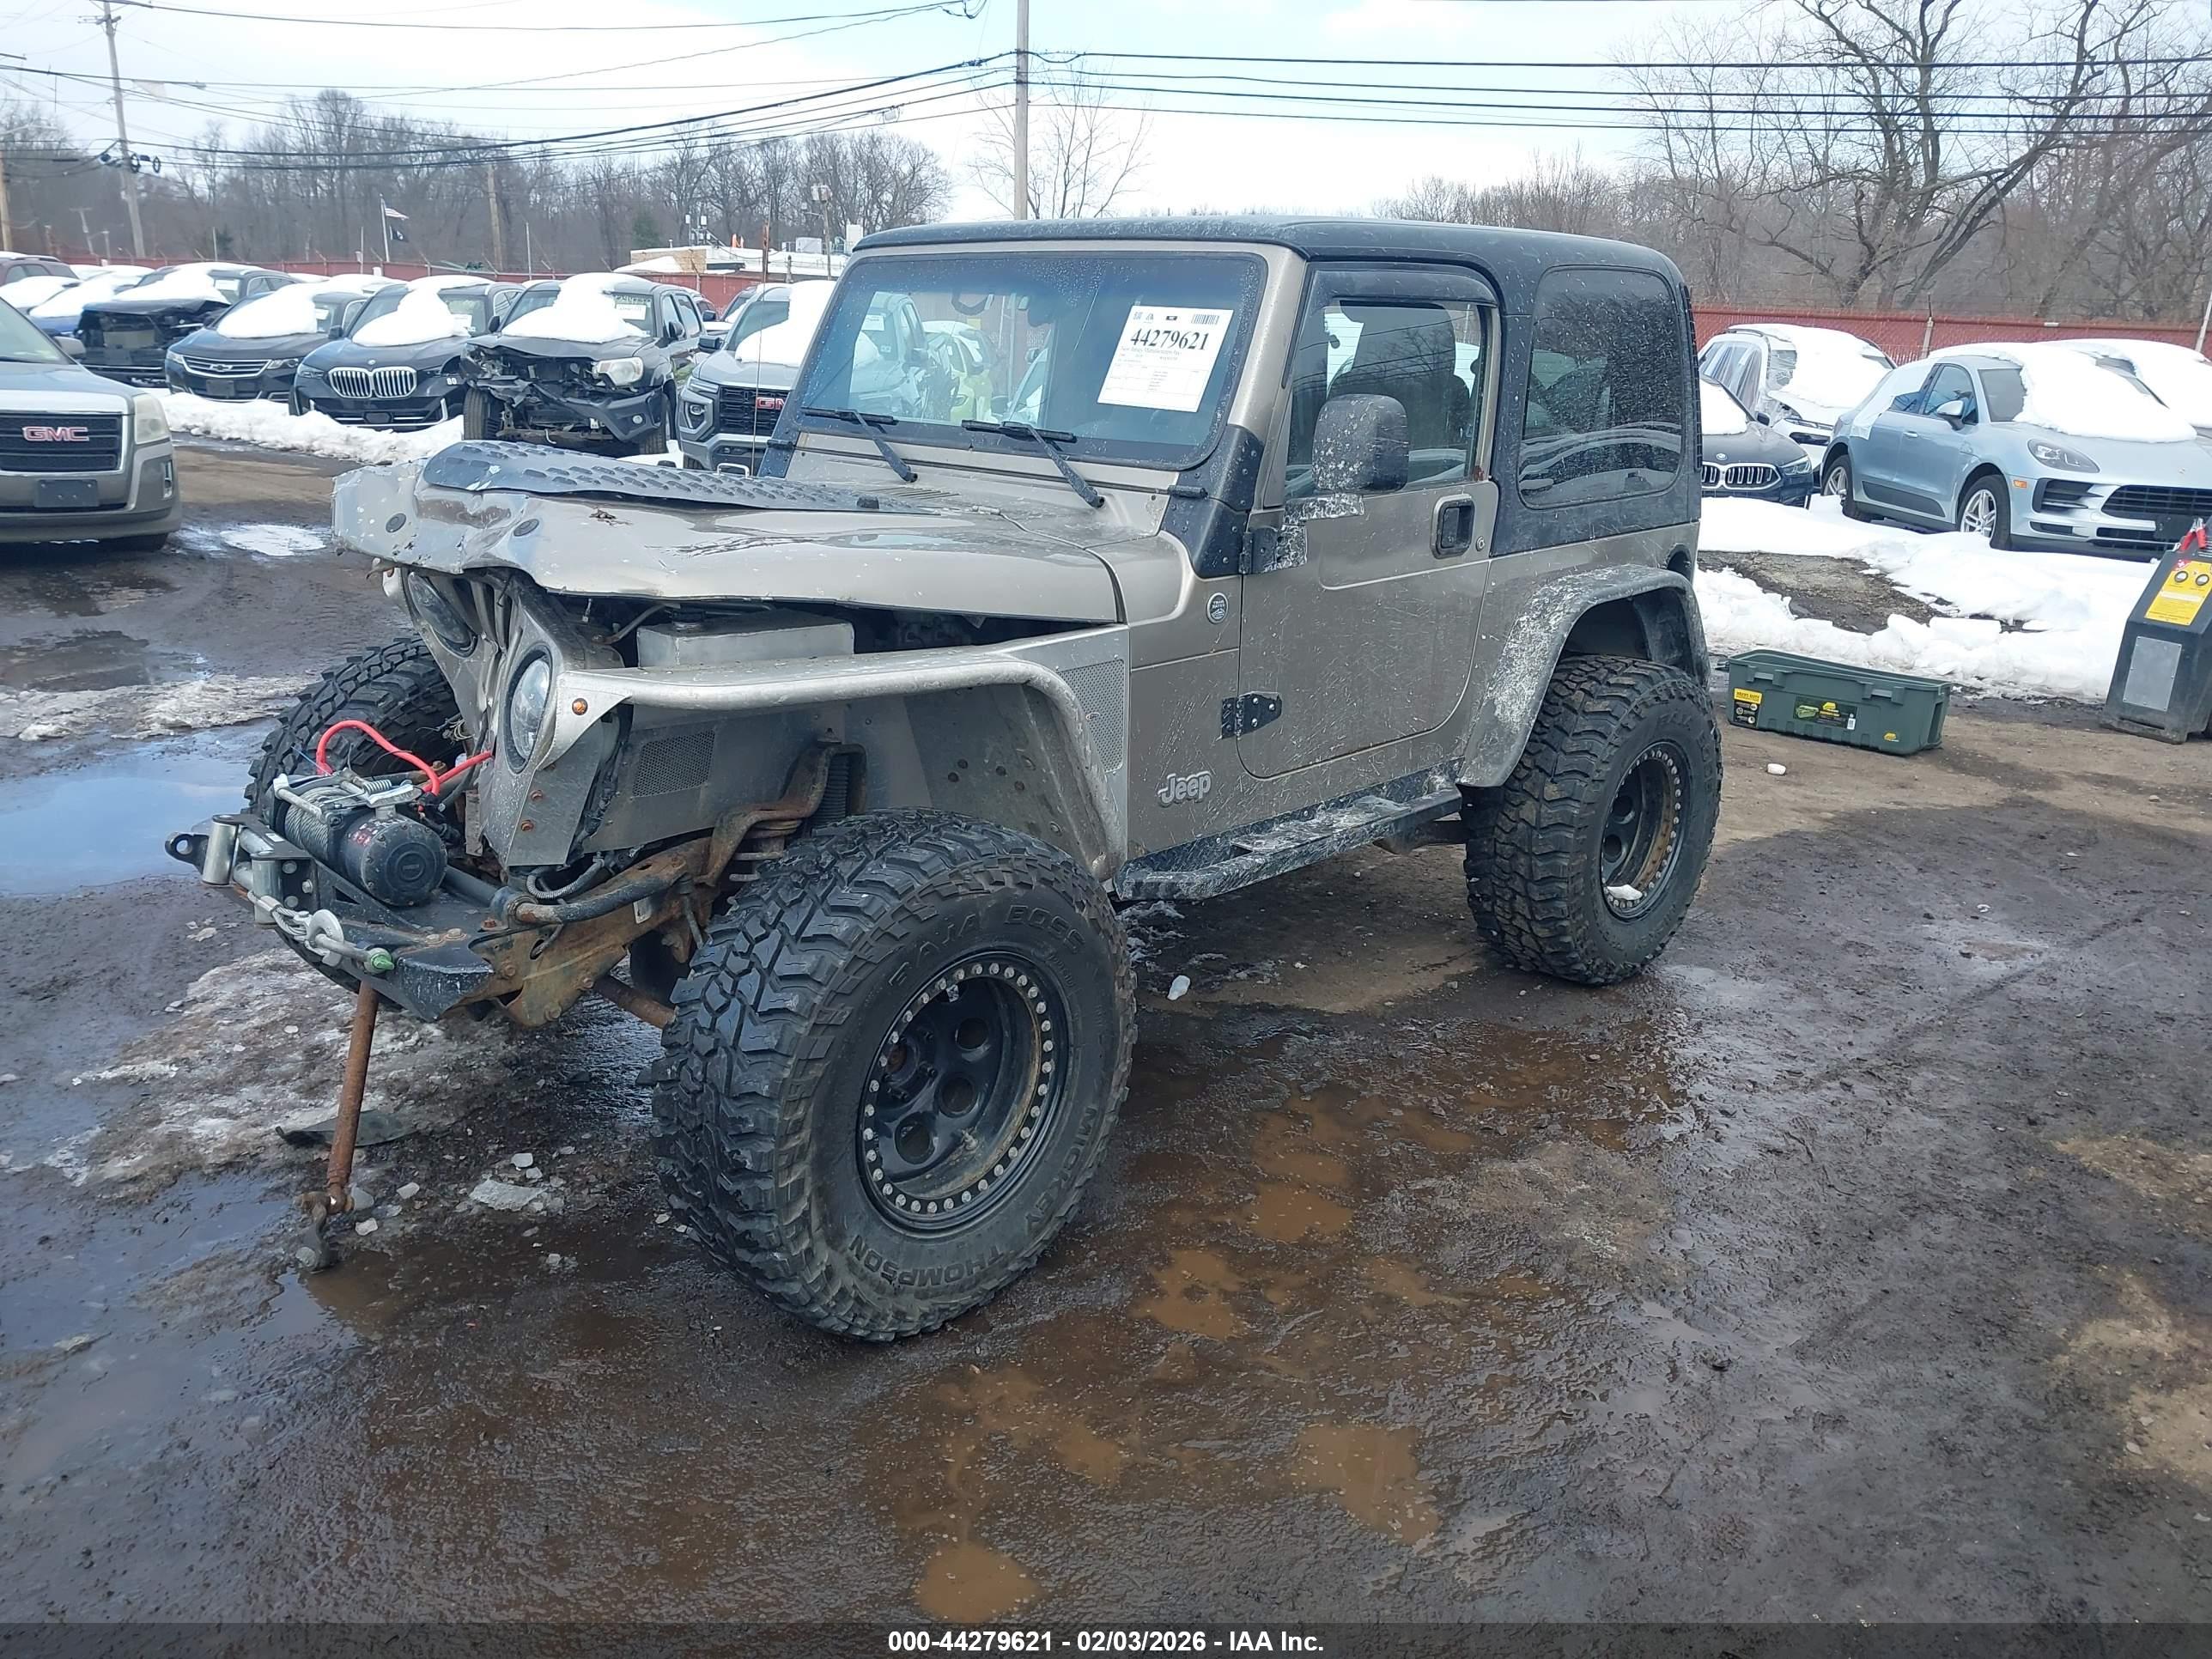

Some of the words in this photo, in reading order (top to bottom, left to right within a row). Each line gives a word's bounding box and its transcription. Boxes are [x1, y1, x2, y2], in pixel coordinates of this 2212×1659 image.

[1130, 328, 1209, 350] 44279621
[22, 427, 89, 441] GMC
[1158, 771, 1212, 805] Jeep
[848, 1234, 1004, 1288] THOMPSON
